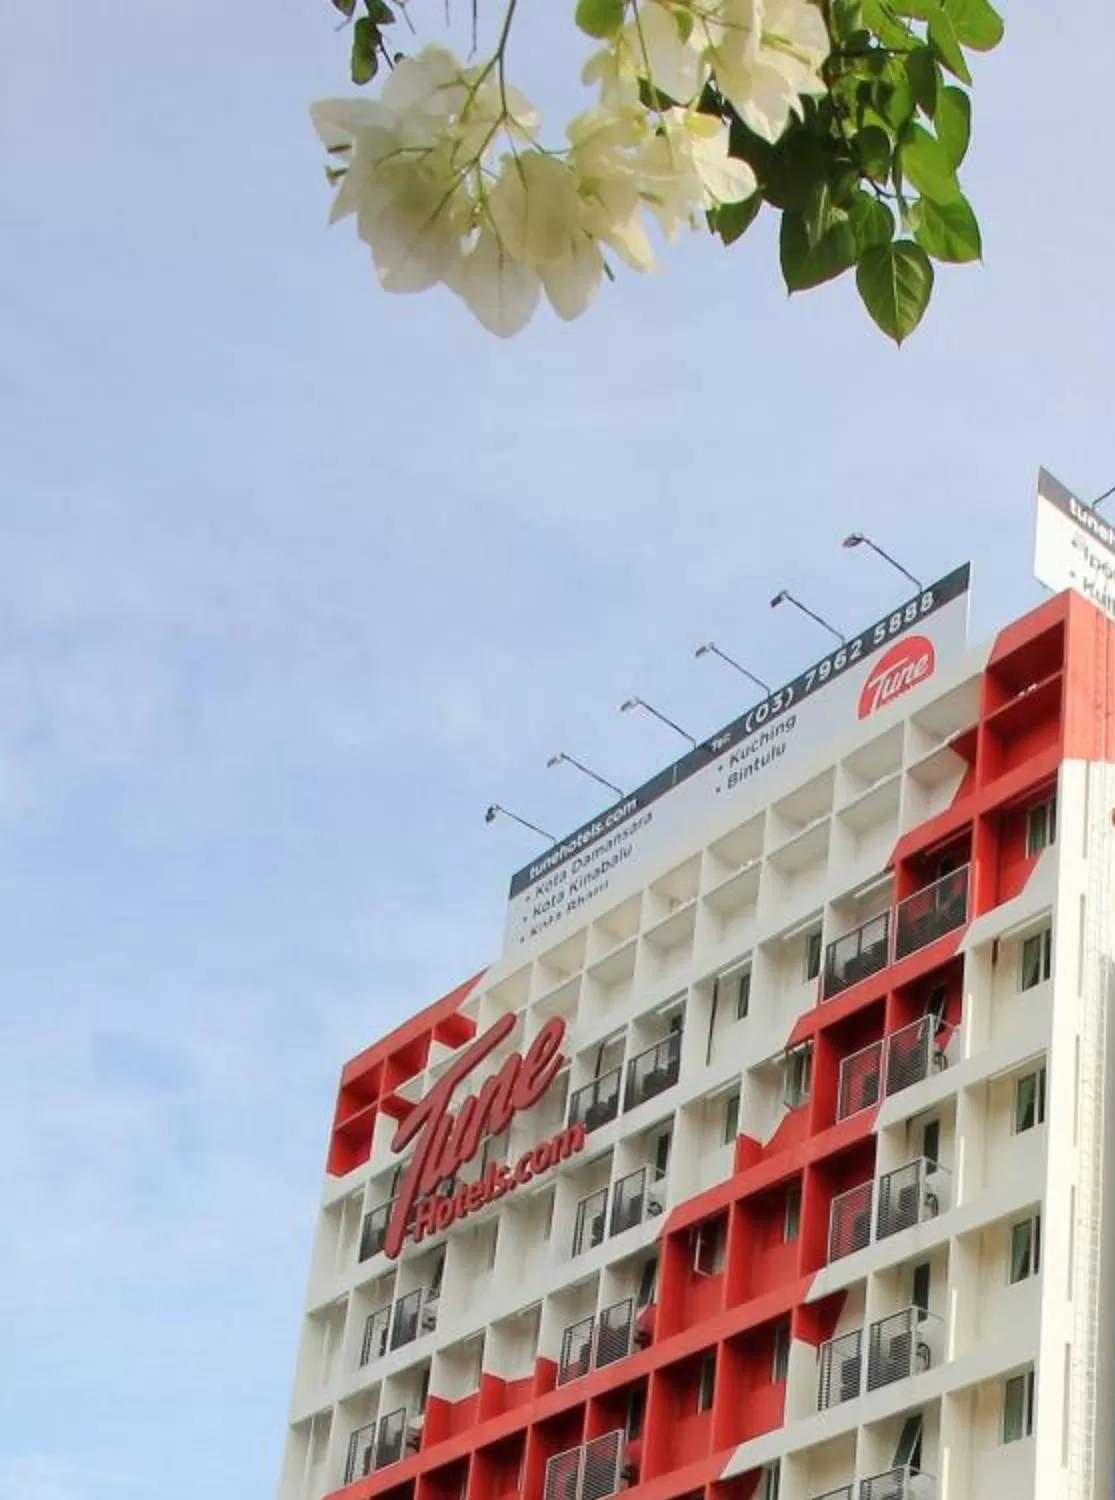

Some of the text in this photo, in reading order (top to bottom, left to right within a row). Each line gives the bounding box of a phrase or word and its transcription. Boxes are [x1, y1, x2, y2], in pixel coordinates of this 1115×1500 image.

[745, 687, 794, 733] (03)
[803, 640, 864, 691] 7962
[873, 591, 934, 644] 5888
[868, 652, 930, 714] Tune
[727, 742, 787, 790] Bintulu
[729, 714, 797, 768] Kuching
[529, 798, 637, 880] tunehotels.com
[384, 1012, 567, 1260] Tune
[407, 1120, 587, 1243] Hotels.com
